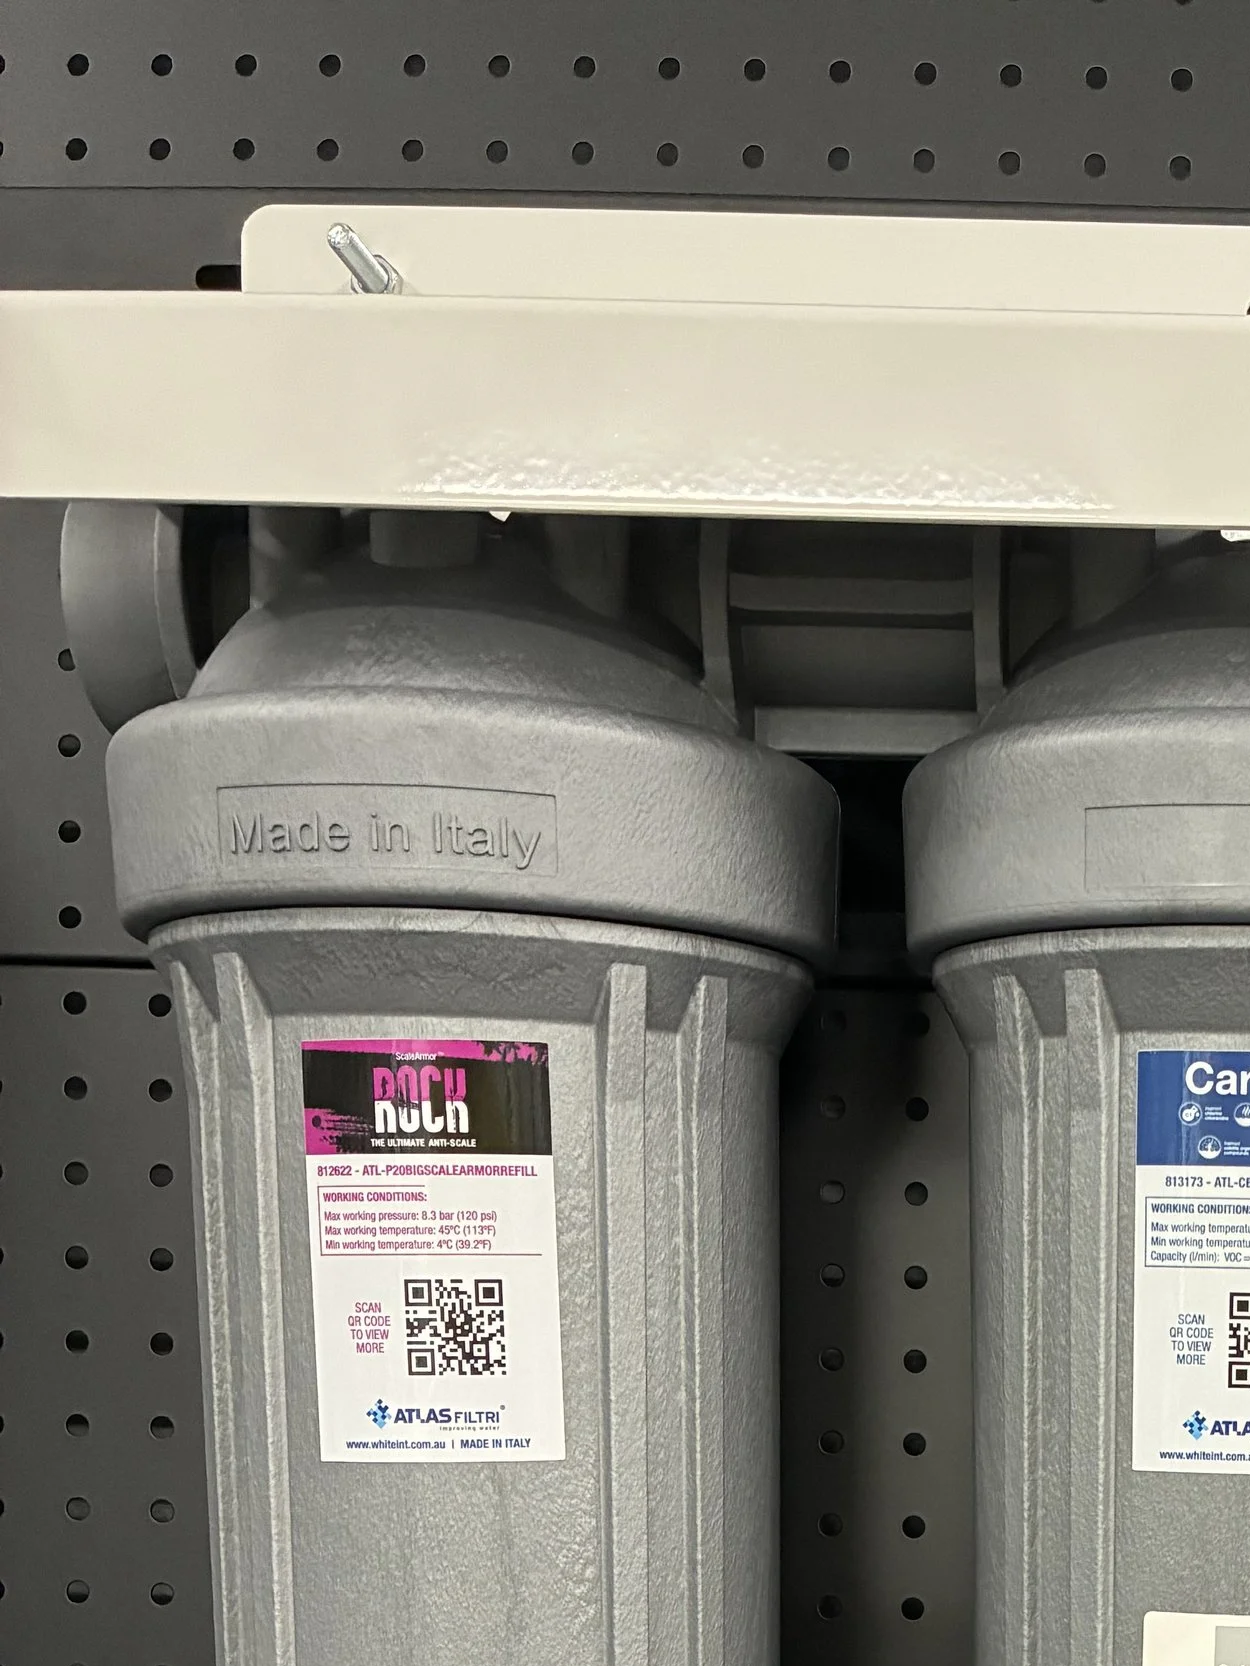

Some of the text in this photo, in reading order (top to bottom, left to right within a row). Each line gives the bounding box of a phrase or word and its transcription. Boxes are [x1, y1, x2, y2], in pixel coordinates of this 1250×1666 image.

[231, 812, 541, 869] Made in Italy
[373, 1065, 469, 1134] ROCK
[370, 1138, 476, 1148] THE ULTIMATE ANTI-SCALE
[317, 1166, 538, 1177] 812622 ATL-P20BIGSCALEARMORREFILL
[1165, 1177, 1203, 1188] 813173
[323, 1192, 427, 1202] WORKING CONDITIONS:
[1151, 1203, 1194, 1213] WORKING
[324, 1211, 497, 1223] Max working pressure: 8.3 bar (120 psi)
[325, 1226, 436, 1237] Max working temperature:
[1151, 1222, 1168, 1232] Max
[1171, 1222, 1206, 1235] working
[325, 1240, 434, 1251] Min working temperature:
[1151, 1237, 1166, 1246] Min
[1169, 1237, 1203, 1249] working
[1151, 1251, 1187, 1263] Capacity
[1224, 1253, 1242, 1262] VOC
[355, 1302, 381, 1313] SCAN
[348, 1316, 391, 1326] QR CODE
[1178, 1315, 1206, 1325] SCAN
[350, 1329, 389, 1340] TO VIEW
[1169, 1328, 1214, 1339] QR CODE
[356, 1343, 384, 1353] MORE
[1171, 1341, 1212, 1352] TO VIEW
[1176, 1354, 1206, 1366] MORE
[394, 1408, 499, 1424] ATLAS FILTRI
[346, 1439, 531, 1449] www.whiteint.com.au MADE IN ITALY
